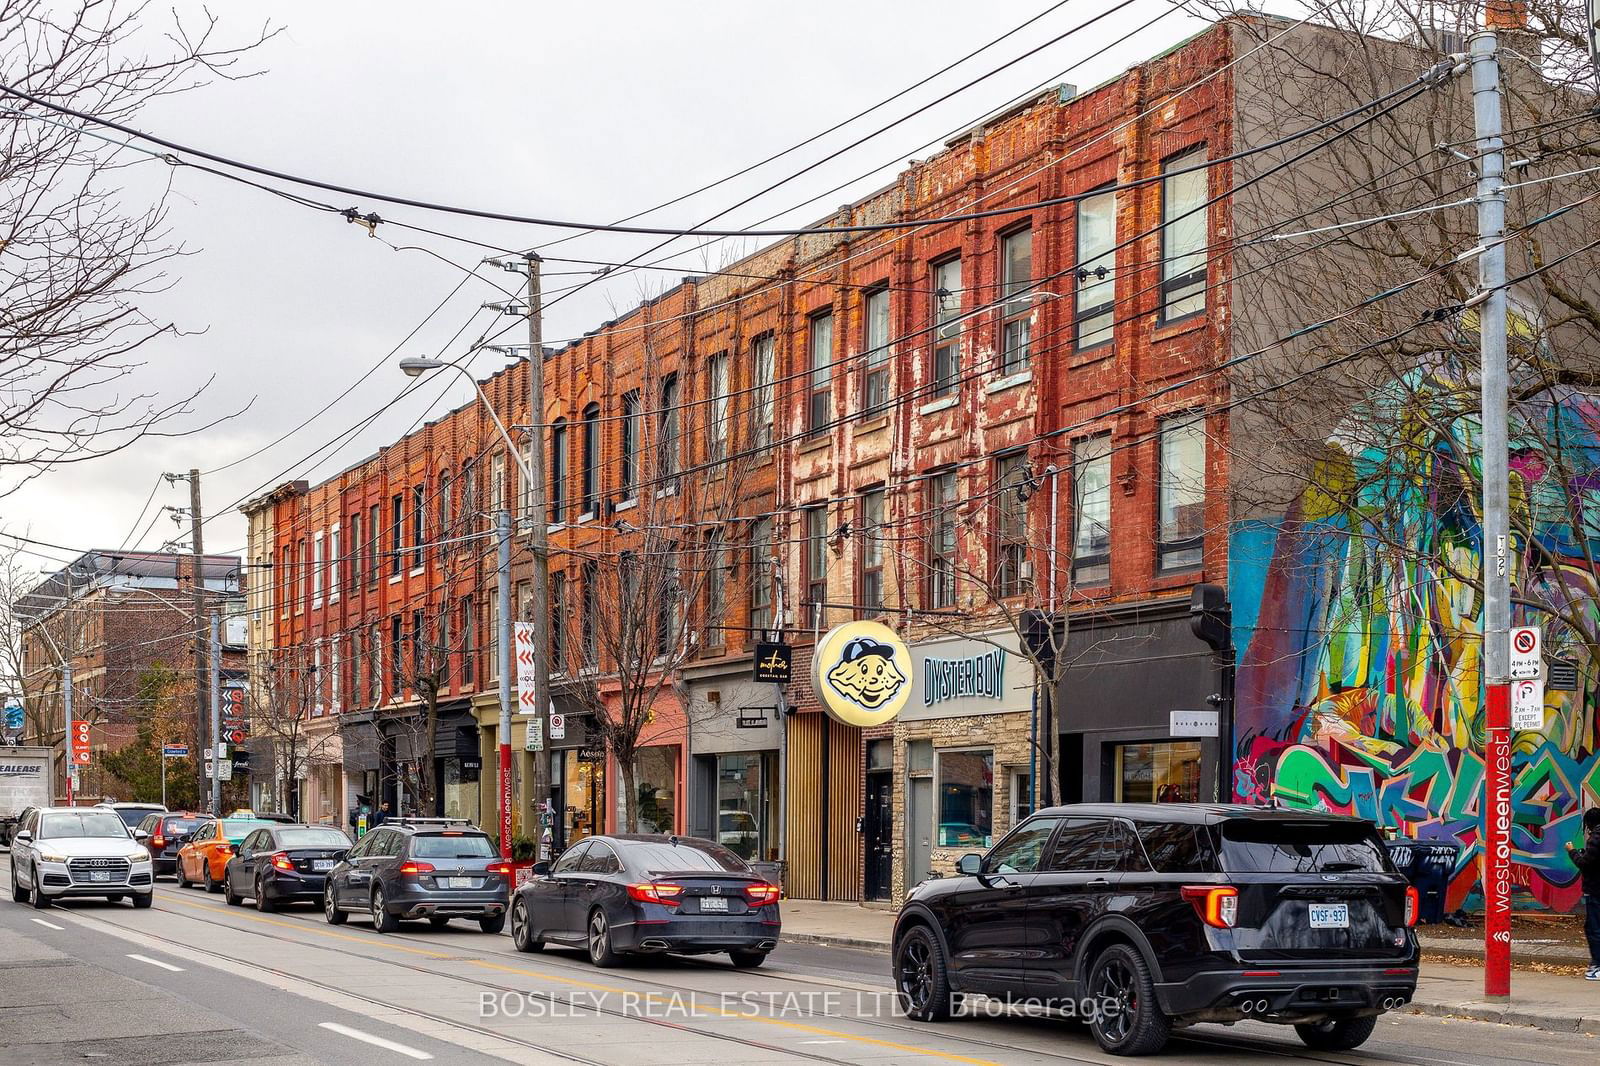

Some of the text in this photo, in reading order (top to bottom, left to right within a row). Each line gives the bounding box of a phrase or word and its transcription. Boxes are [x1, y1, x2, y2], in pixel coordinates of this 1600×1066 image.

[923, 646, 1005, 707] OYSTER BOY
[1518, 714, 1537, 722] EXCEPT
[1514, 721, 1521, 729] BY
[1333, 909, 1347, 922] 937
